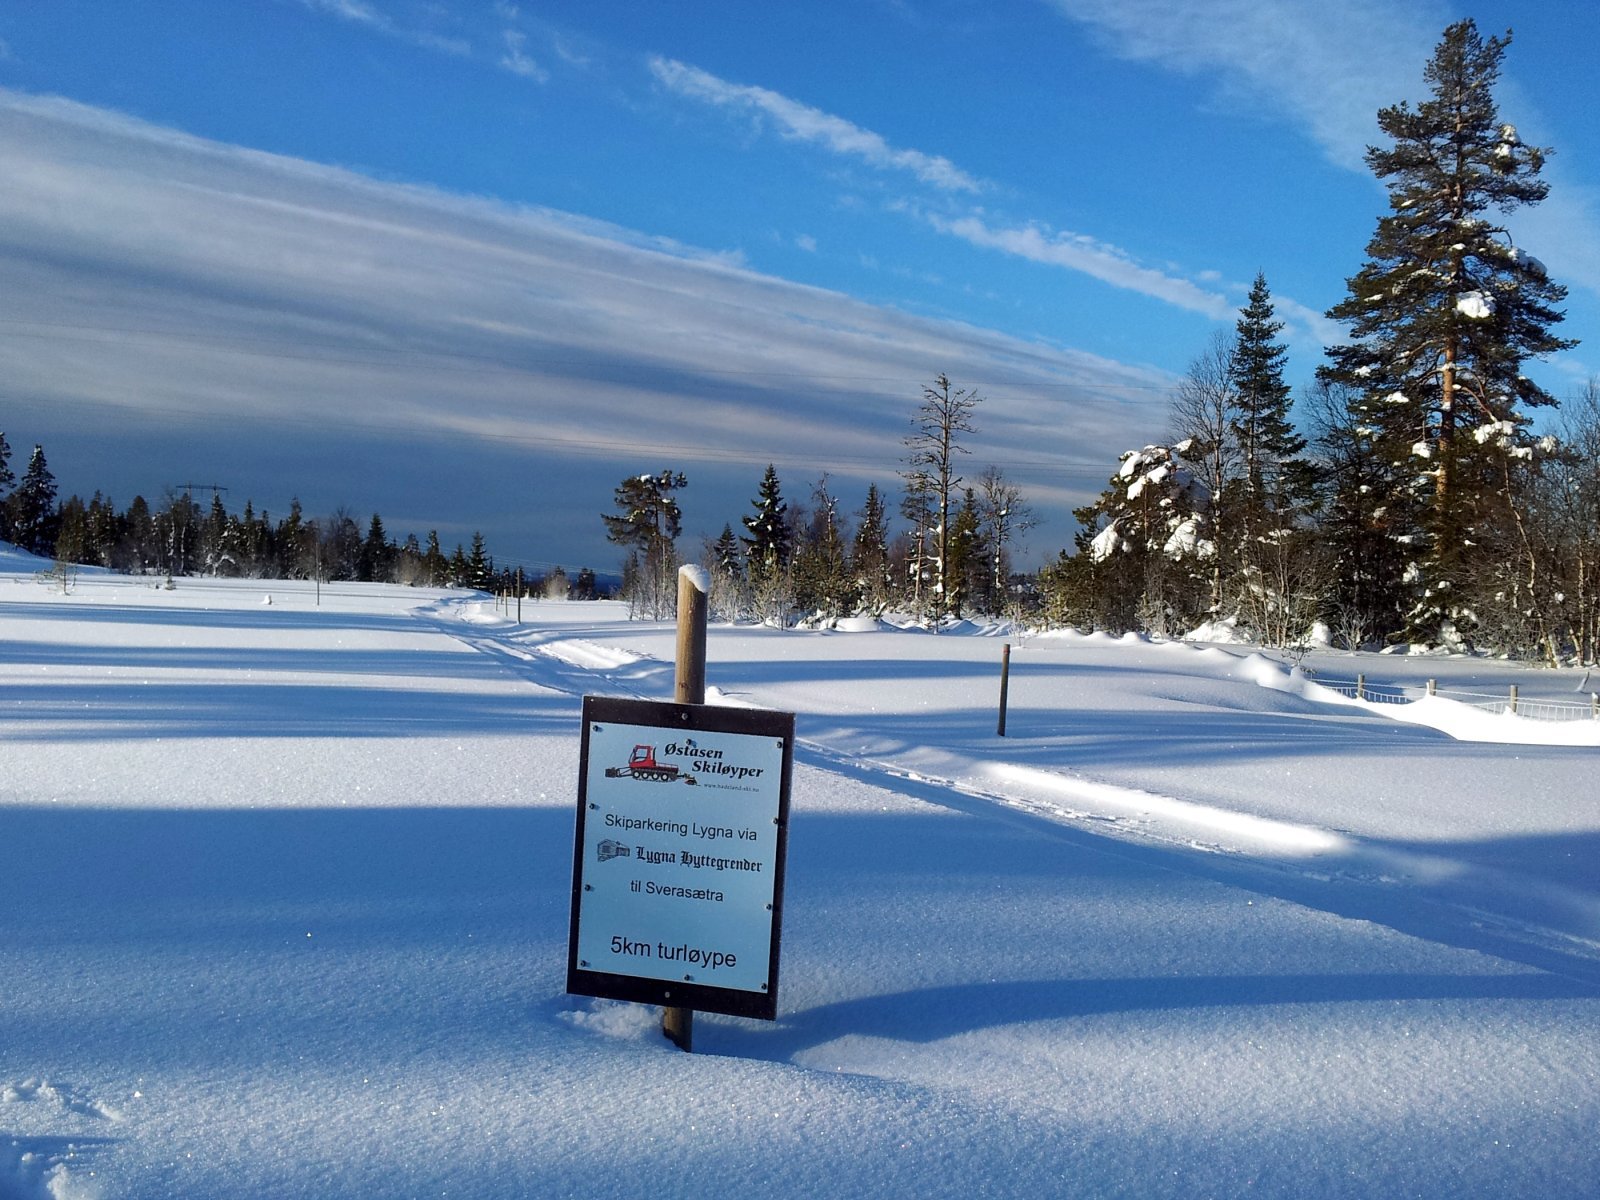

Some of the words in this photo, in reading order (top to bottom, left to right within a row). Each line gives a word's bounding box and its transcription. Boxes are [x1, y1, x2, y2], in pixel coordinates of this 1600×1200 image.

[692, 760, 763, 779] Skiløyper
[605, 814, 688, 836] Skiparkering
[692, 823, 733, 840] Lygna
[738, 828, 757, 841] via
[636, 847, 676, 864] Lygna
[680, 850, 763, 872] Hyttegrender
[630, 880, 641, 892] til
[645, 882, 723, 902] Sverasætra
[610, 935, 651, 957] 5km
[657, 942, 737, 969] turløype
